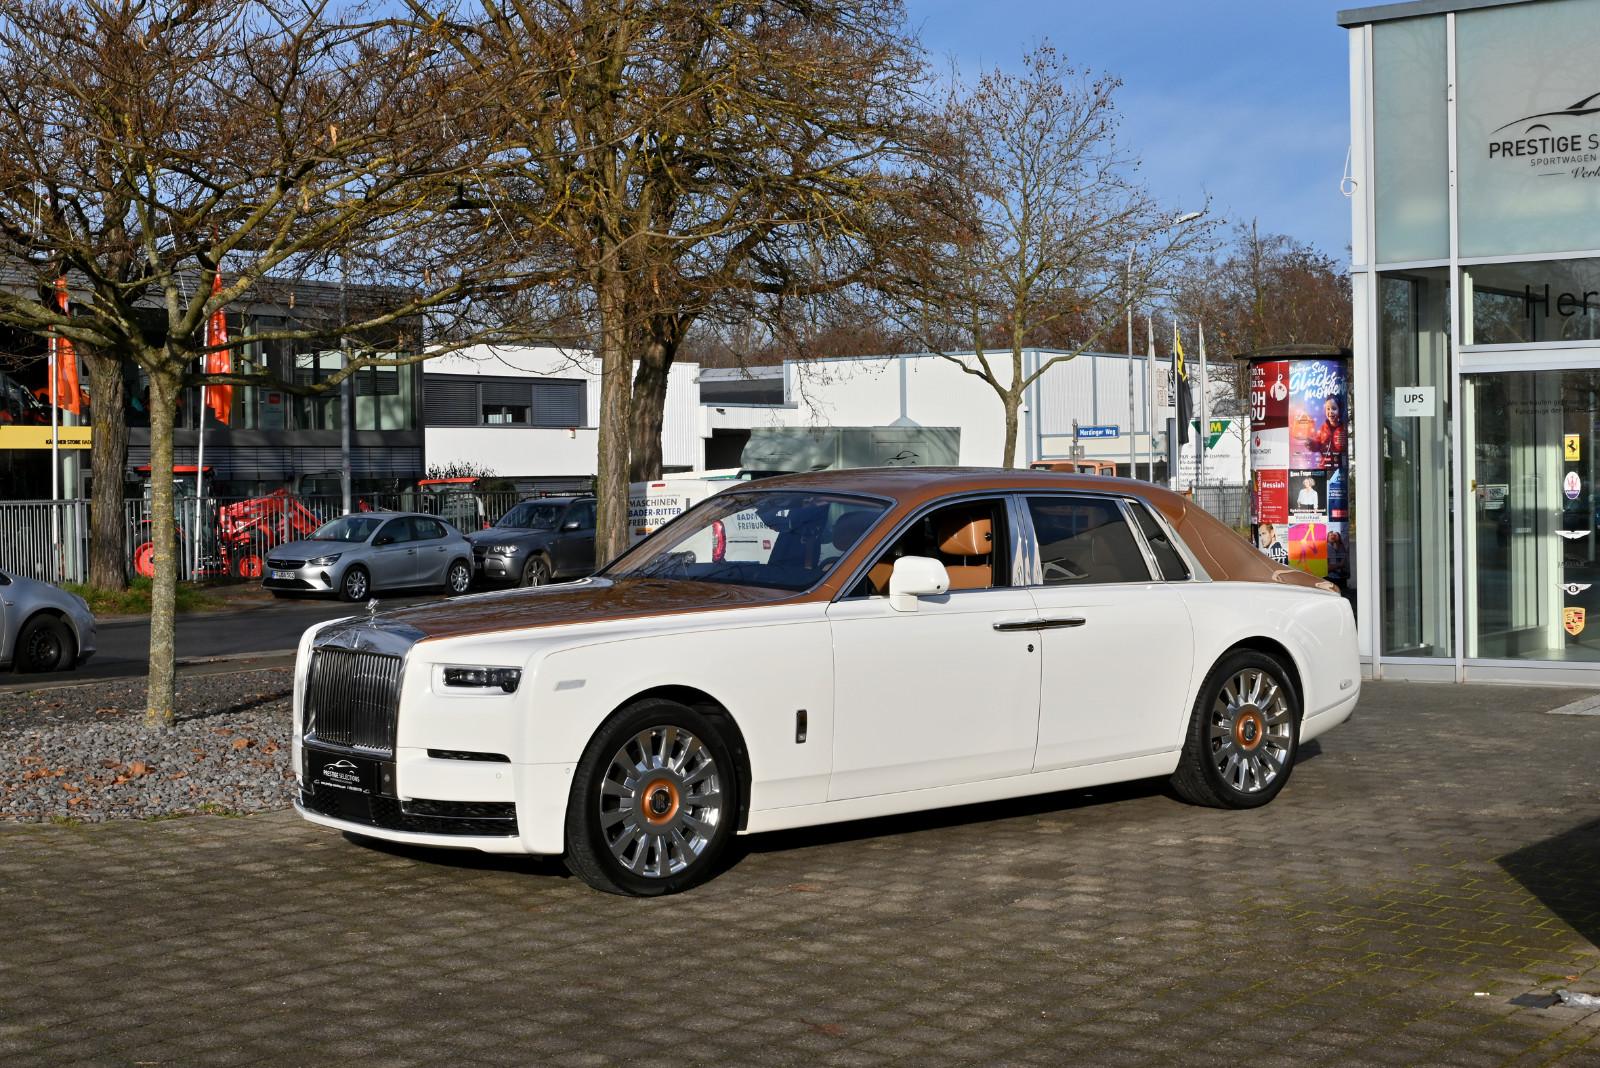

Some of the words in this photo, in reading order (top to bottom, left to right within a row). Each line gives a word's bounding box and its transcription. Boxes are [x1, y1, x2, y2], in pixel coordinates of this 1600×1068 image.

[1489, 135, 1582, 159] PRESTIGE
[1530, 154, 1597, 167] SPORTWAGEN
[1525, 284, 1599, 319] Her
[1404, 393, 1424, 404] UPS
[1105, 428, 1116, 436] Weg
[1262, 481, 1285, 489] Messiah
[629, 498, 678, 508] MASCHINEN
[628, 507, 682, 517] BADER-RITTER
[628, 517, 666, 527] FREIBURG
